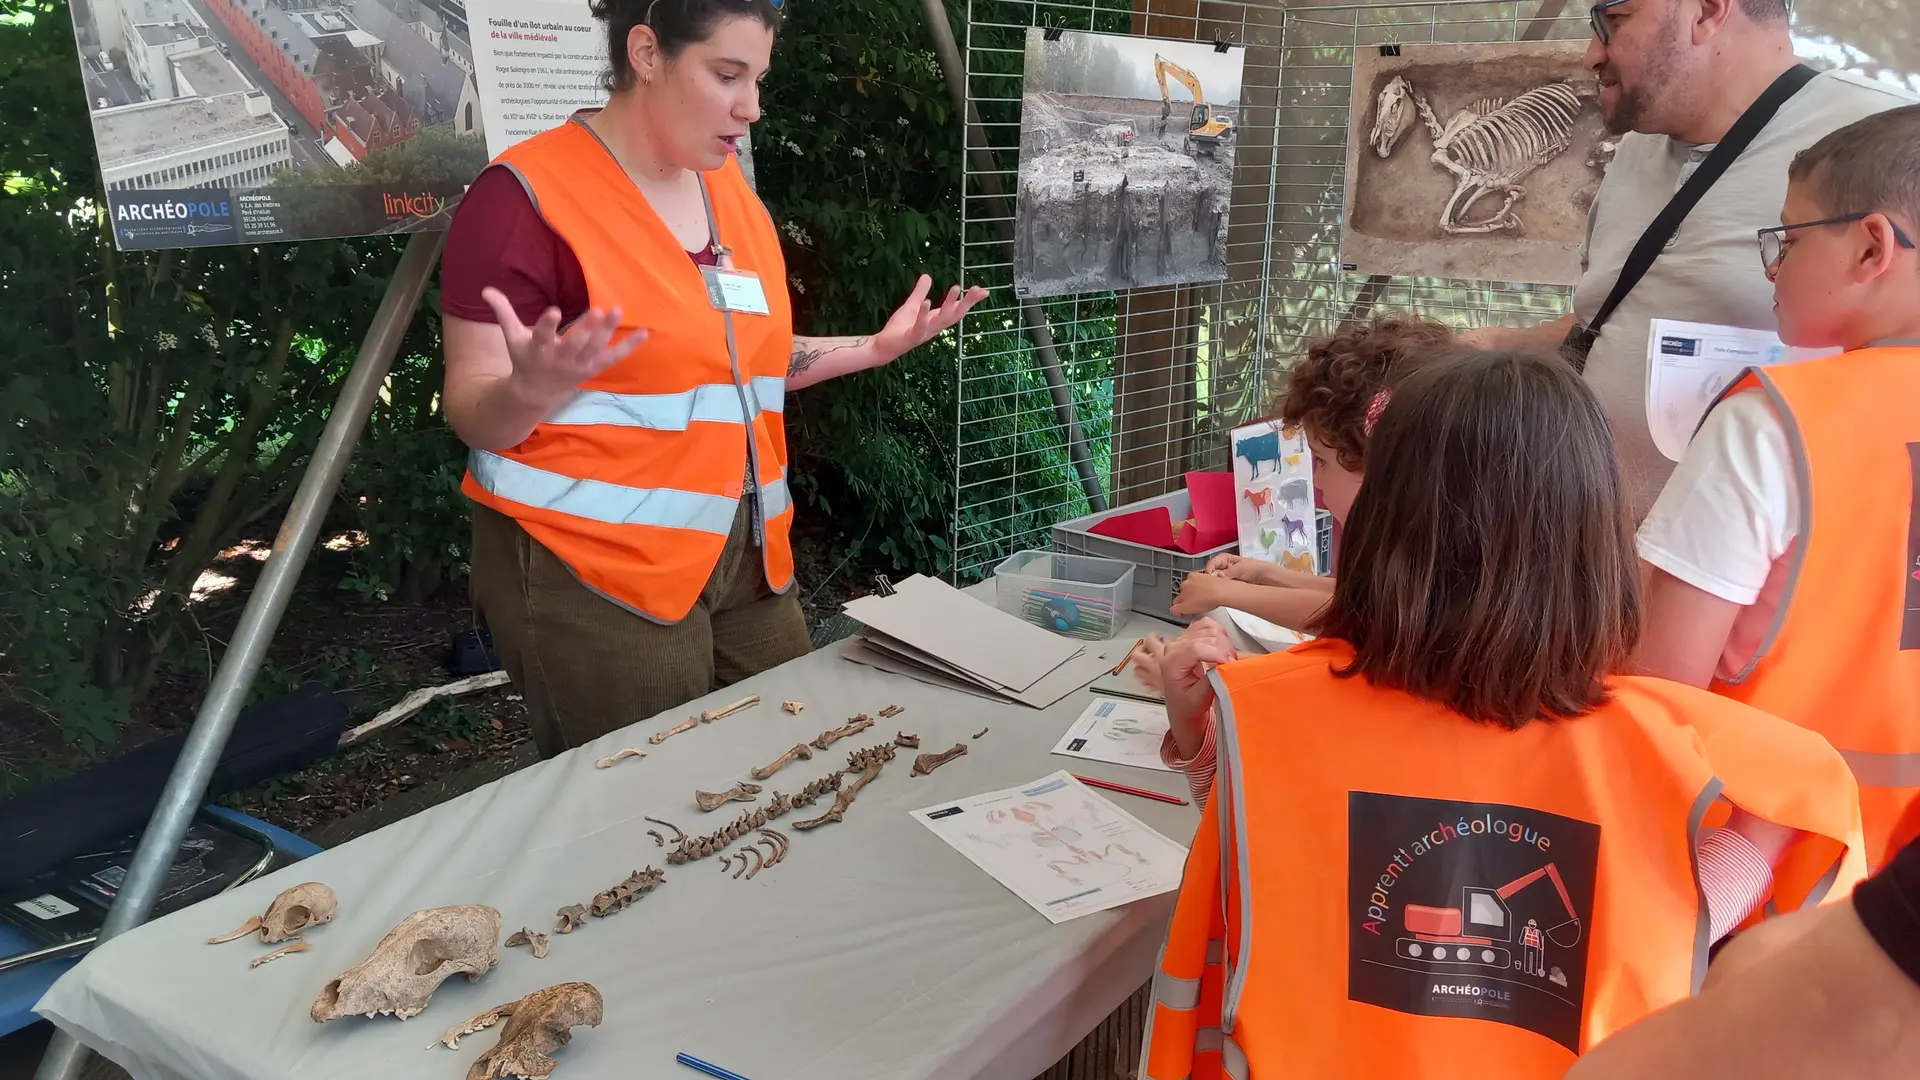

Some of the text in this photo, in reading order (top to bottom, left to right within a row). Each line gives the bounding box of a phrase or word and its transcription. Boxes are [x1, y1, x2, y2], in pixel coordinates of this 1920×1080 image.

[489, 18, 512, 28] Fouille
[513, 20, 528, 29] d'un
[542, 22, 563, 31] urbain
[491, 30, 558, 42] de la ville médiévale
[510, 67, 530, 75] Salengro
[118, 199, 230, 220] ARCHÉOPOLE
[383, 191, 444, 218] linkcity
[1362, 814, 1550, 935] Apprenti archéologue
[1432, 984, 1510, 1000] ARCHÉOPOLE
